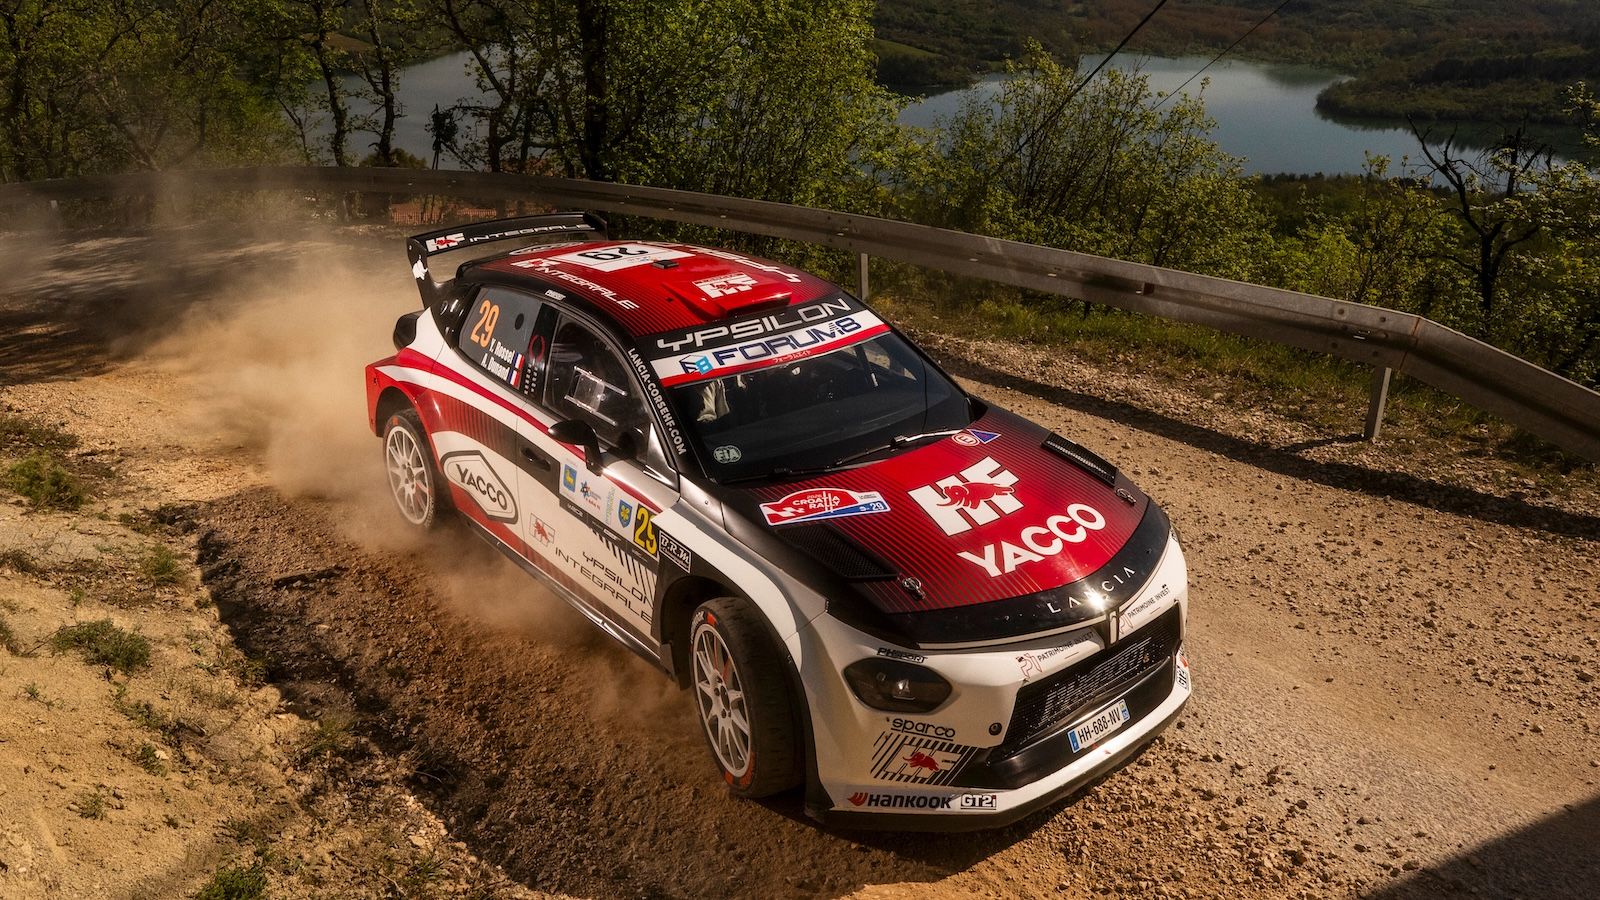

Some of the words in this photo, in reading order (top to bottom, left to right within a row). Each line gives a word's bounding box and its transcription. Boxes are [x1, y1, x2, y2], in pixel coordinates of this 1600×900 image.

[469, 224, 595, 243] INTEGRALE
[534, 266, 640, 310] INTEGRALE
[470, 300, 500, 348] 29
[657, 298, 852, 351] YPSILON
[712, 317, 862, 366] FORUM8
[715, 448, 740, 461] FIA
[456, 463, 507, 511] YACCO
[792, 493, 841, 506] CROATIA
[956, 502, 1106, 578] YACCO
[556, 546, 653, 626] INTEGRALE
[1127, 598, 1157, 618] PATRIMOINE
[1155, 587, 1171, 602] INVEST
[1037, 642, 1074, 663] PATRIMOINE
[892, 718, 956, 738] sparco
[1077, 707, 1121, 744] HH-688-NV
